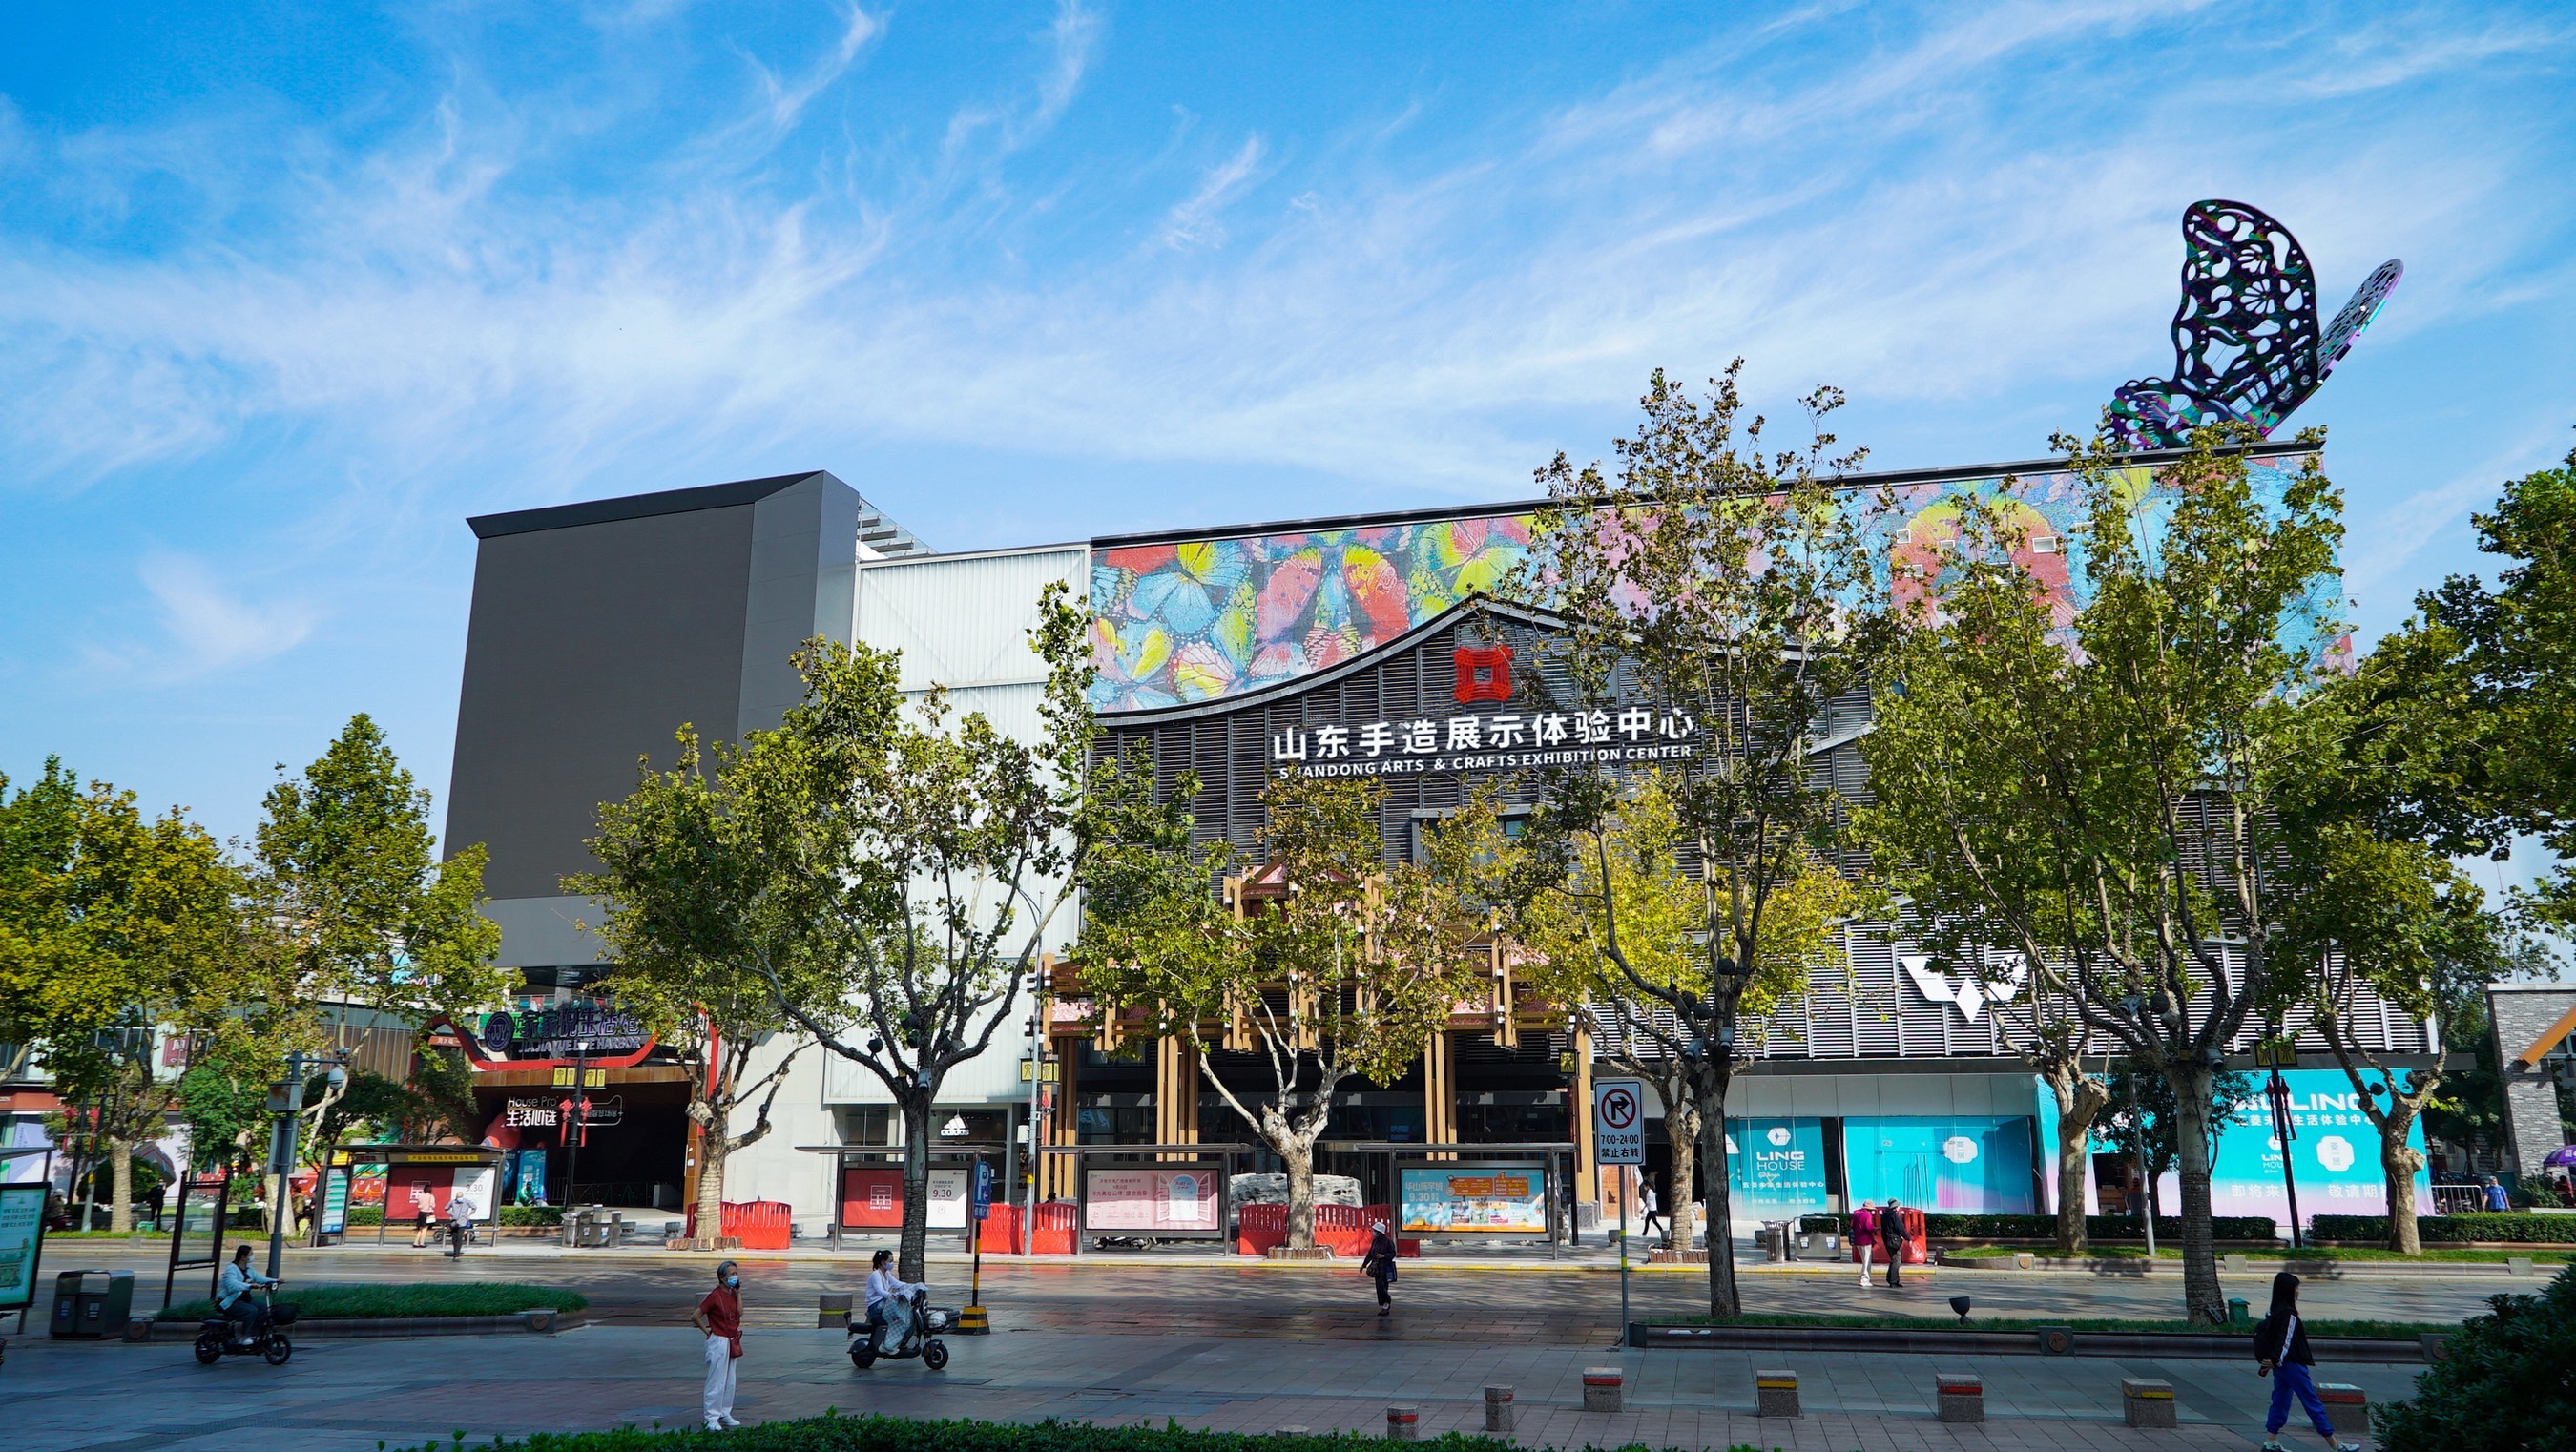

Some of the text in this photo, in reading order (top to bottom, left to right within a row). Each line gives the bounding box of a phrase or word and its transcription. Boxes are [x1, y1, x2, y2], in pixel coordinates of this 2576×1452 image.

[1274, 707, 1693, 760] 山东手造展示体验中心
[1381, 758, 1424, 773] ARTS
[1434, 757, 1445, 770] &
[1453, 753, 1517, 770] CRAFTS
[1522, 747, 1621, 765] EXHIBITION
[1626, 745, 1692, 759] CENTER
[522, 1008, 640, 1038] 家家悦生活馆
[574, 1038, 596, 1050] LE
[597, 1036, 641, 1049] HARBOR
[508, 1097, 538, 1108] House
[506, 1109, 557, 1127] 生活心选
[2236, 1113, 2376, 1126] 菱未生活体验中心
[1601, 1134, 1639, 1145] 7:00-24:00
[1602, 1148, 1639, 1158] 禁止右转
[1756, 1151, 1805, 1161] LING
[1756, 1161, 1805, 1171] HOUSE
[466, 1184, 484, 1193] 9.30
[932, 1189, 952, 1198] 9.30
[1408, 1193, 1429, 1202] 9.30
